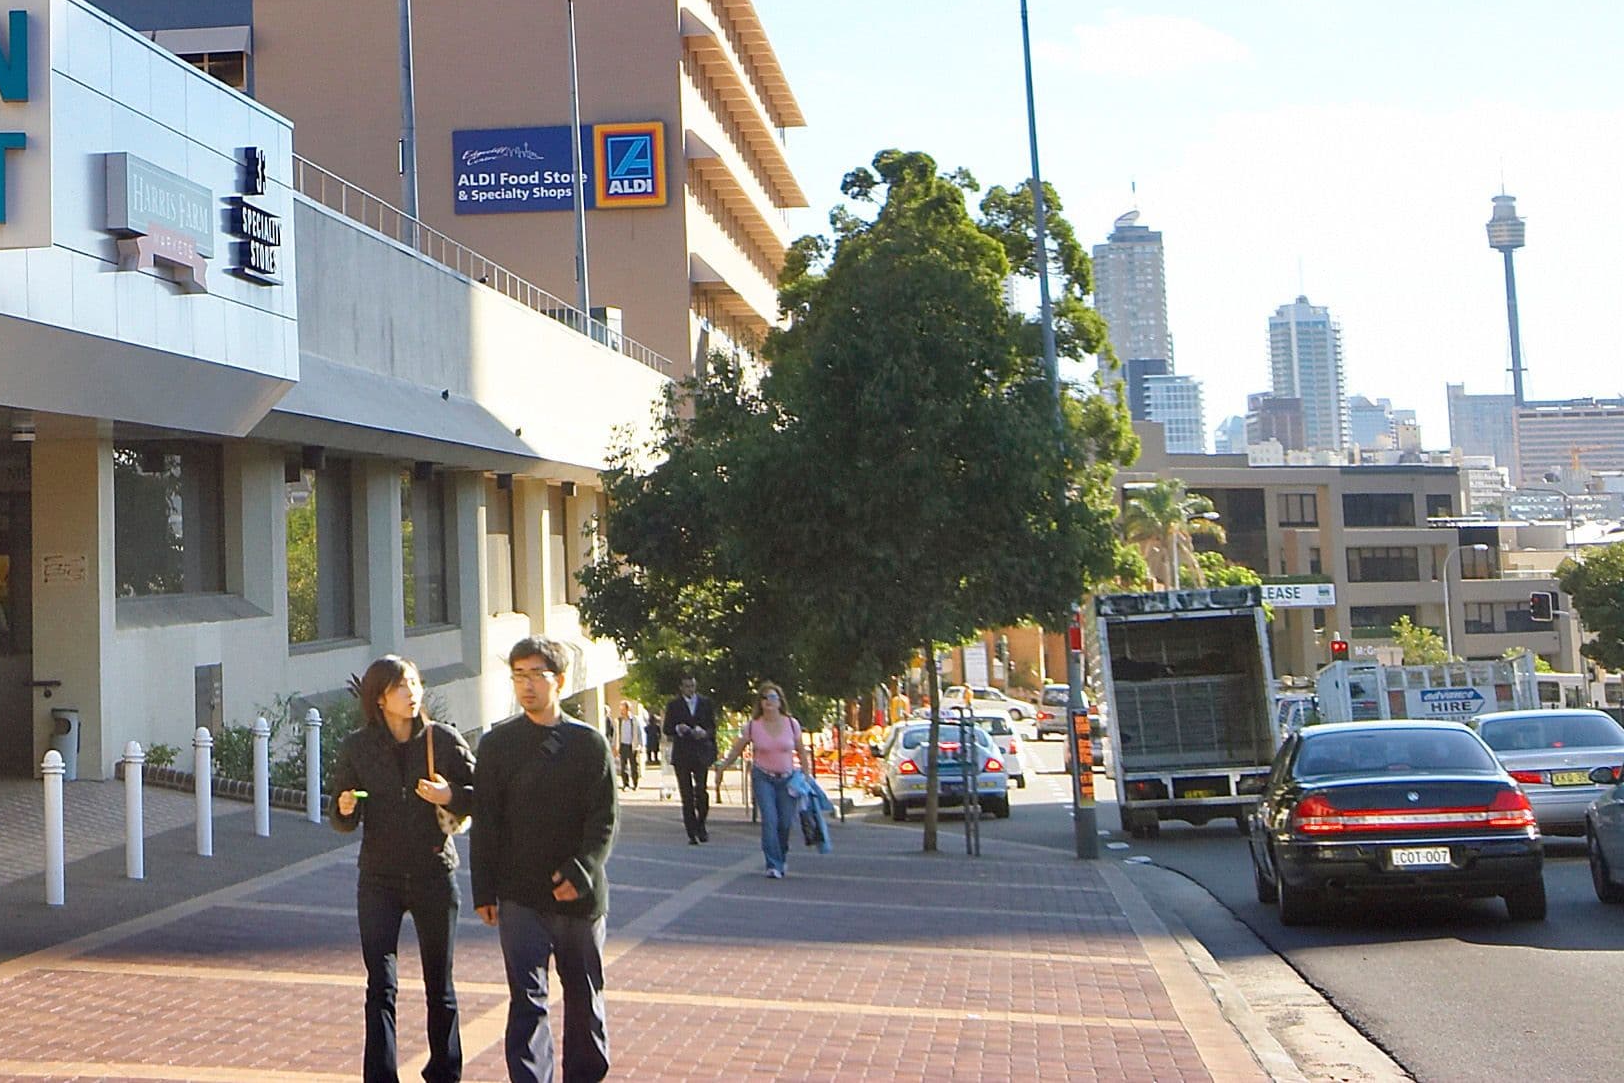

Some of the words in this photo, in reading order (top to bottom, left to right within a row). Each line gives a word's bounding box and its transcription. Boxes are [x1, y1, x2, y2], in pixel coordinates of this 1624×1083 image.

[457, 173, 496, 187] ALDI
[500, 171, 539, 186] Food
[608, 179, 653, 194] ALDI
[458, 190, 468, 202] &
[471, 187, 530, 202] Specialty
[532, 186, 573, 201] Shops
[179, 190, 210, 235] FARM
[1431, 701, 1473, 713] HIRE
